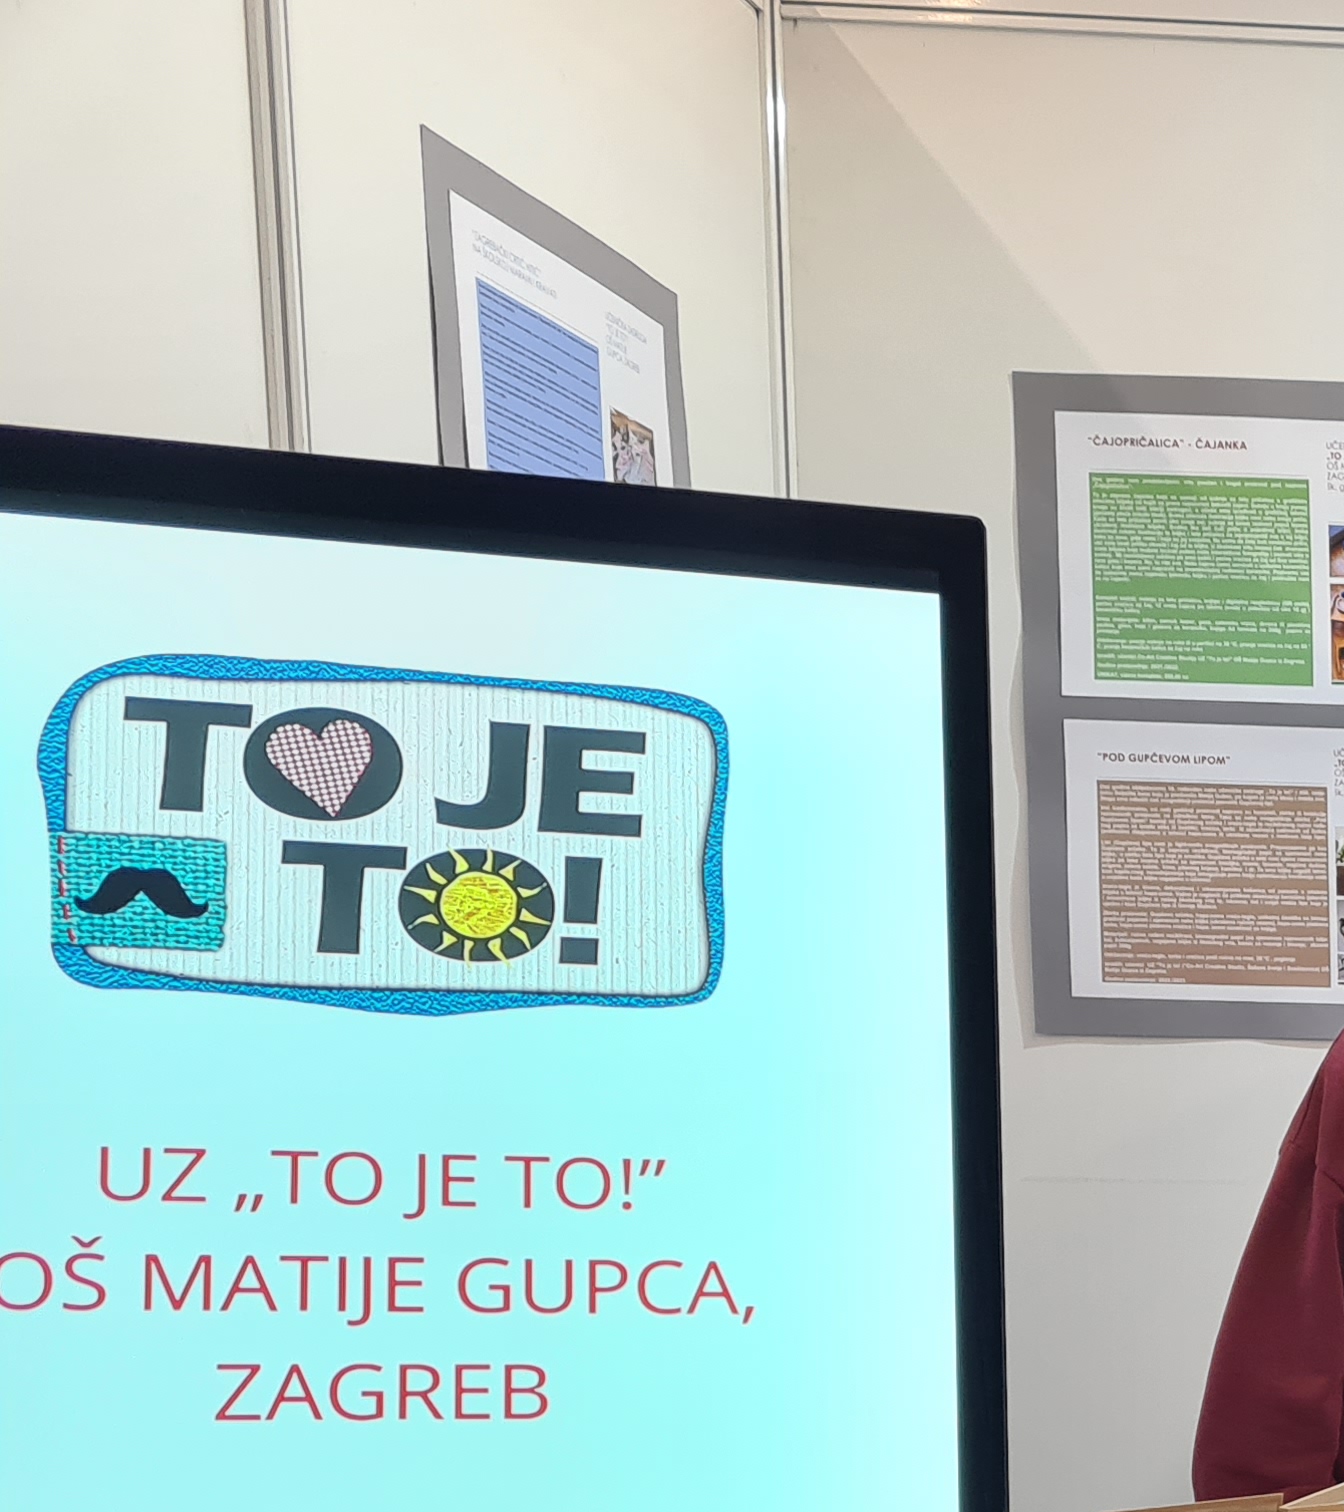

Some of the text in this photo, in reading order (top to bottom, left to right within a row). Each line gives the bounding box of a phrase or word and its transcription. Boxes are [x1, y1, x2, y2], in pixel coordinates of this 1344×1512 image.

[1195, 437, 1248, 450] ČAJANKA
[123, 695, 647, 838] TO JE
[1128, 752, 1190, 765] GUPČEVOM
[281, 840, 603, 965] TO!
[98, 1145, 207, 1203] UZ
[402, 1153, 478, 1220] JE
[0, 1235, 757, 1327] OŠ MATIJE GUPCA,
[214, 1362, 550, 1422] ZAGREB
